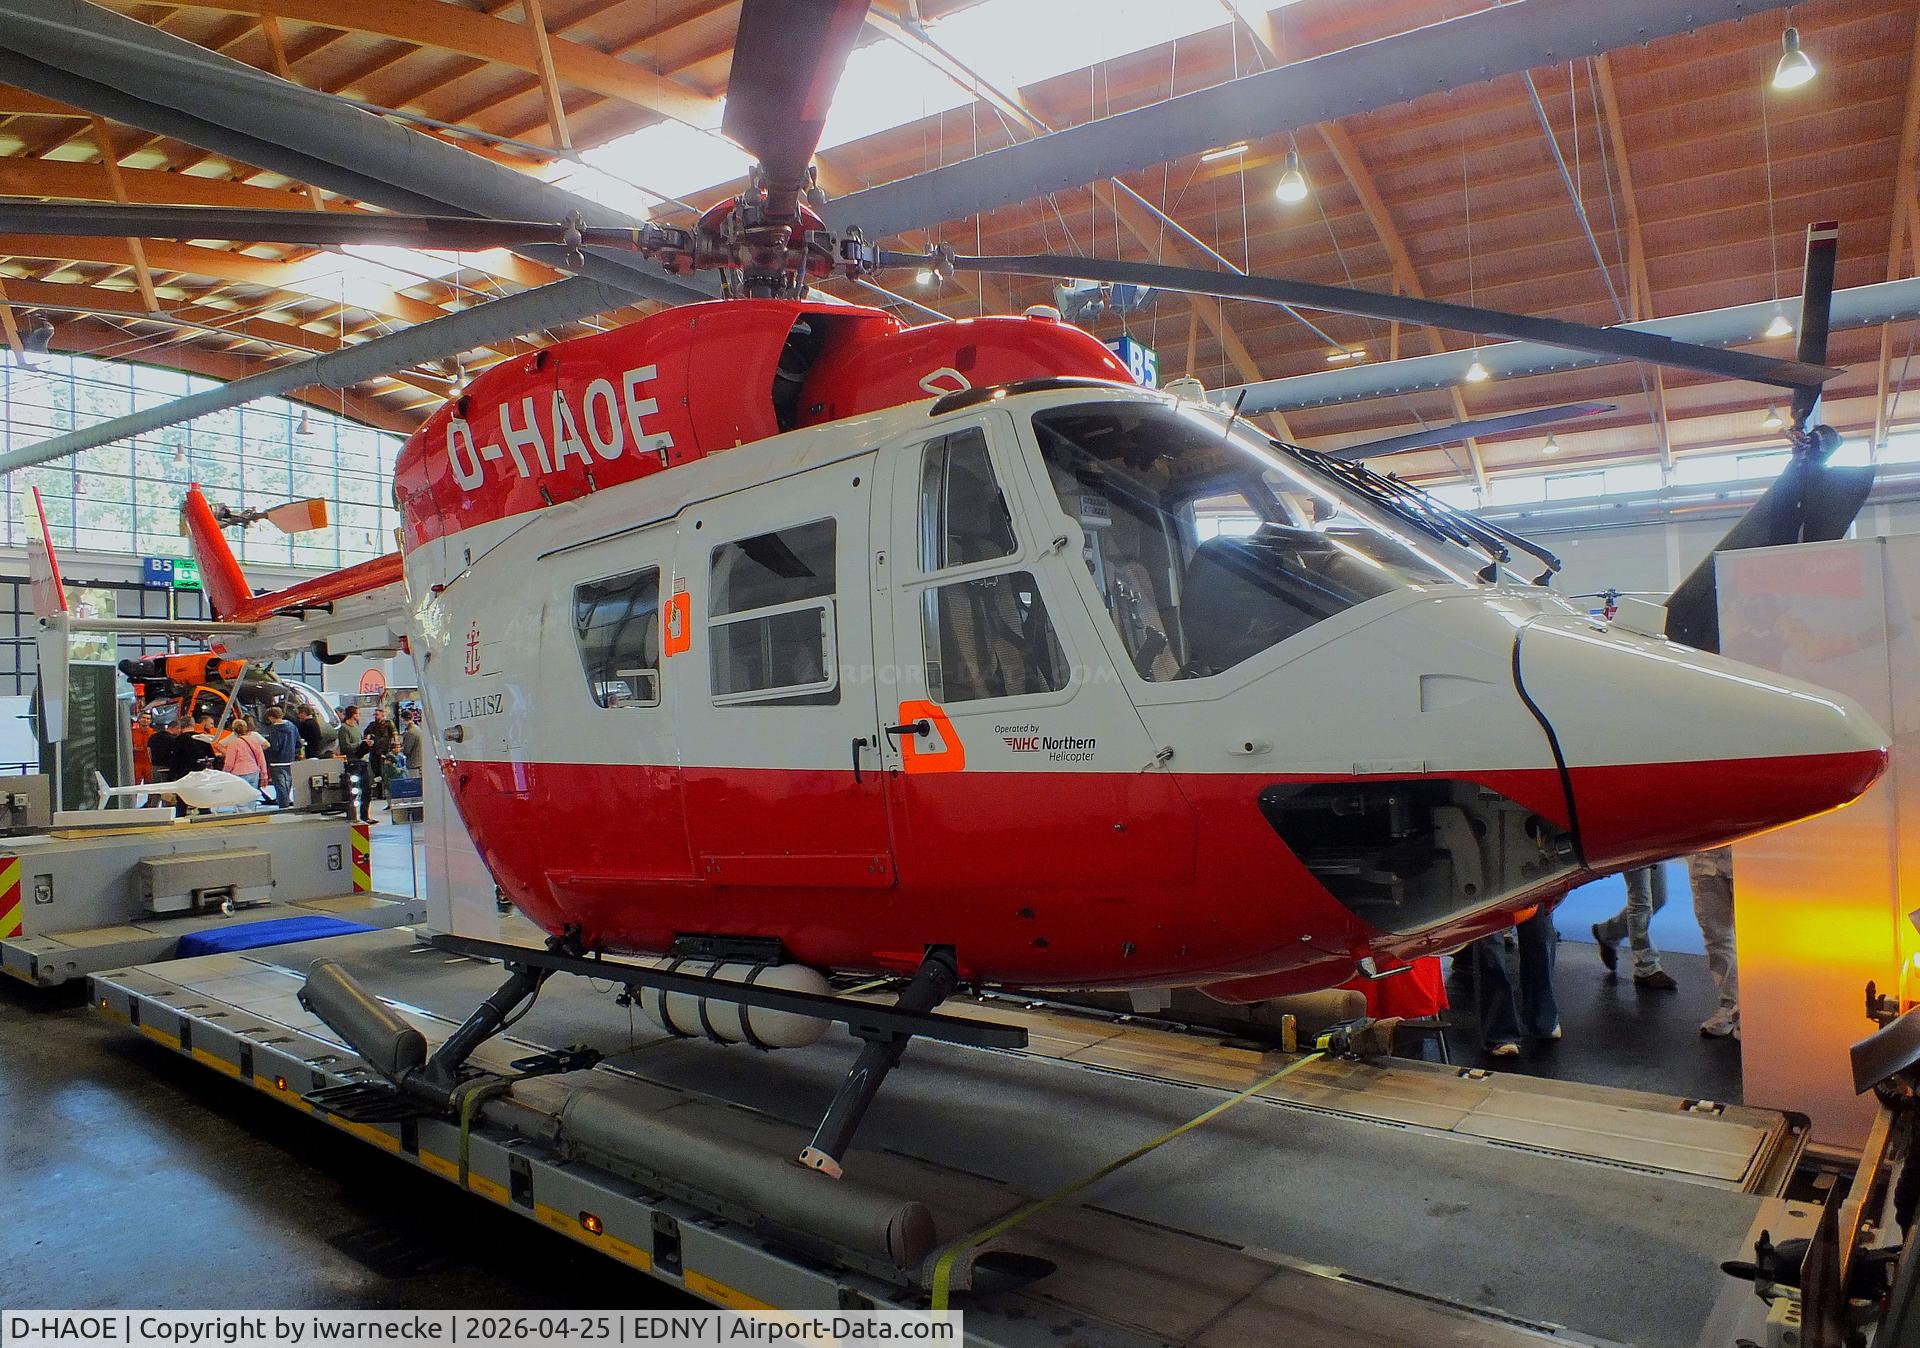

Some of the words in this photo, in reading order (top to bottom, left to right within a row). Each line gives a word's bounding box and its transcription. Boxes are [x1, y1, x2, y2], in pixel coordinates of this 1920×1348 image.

[1130, 341, 1157, 389] B5
[447, 364, 675, 492] D-HAOE
[152, 559, 173, 572] B5
[460, 694, 504, 720] LAEISZ
[994, 724, 1029, 735] Operated
[1030, 724, 1040, 734] by
[1012, 737, 1040, 751] NHC
[1042, 736, 1096, 750] Northern
[1049, 751, 1095, 764] Helicopter
